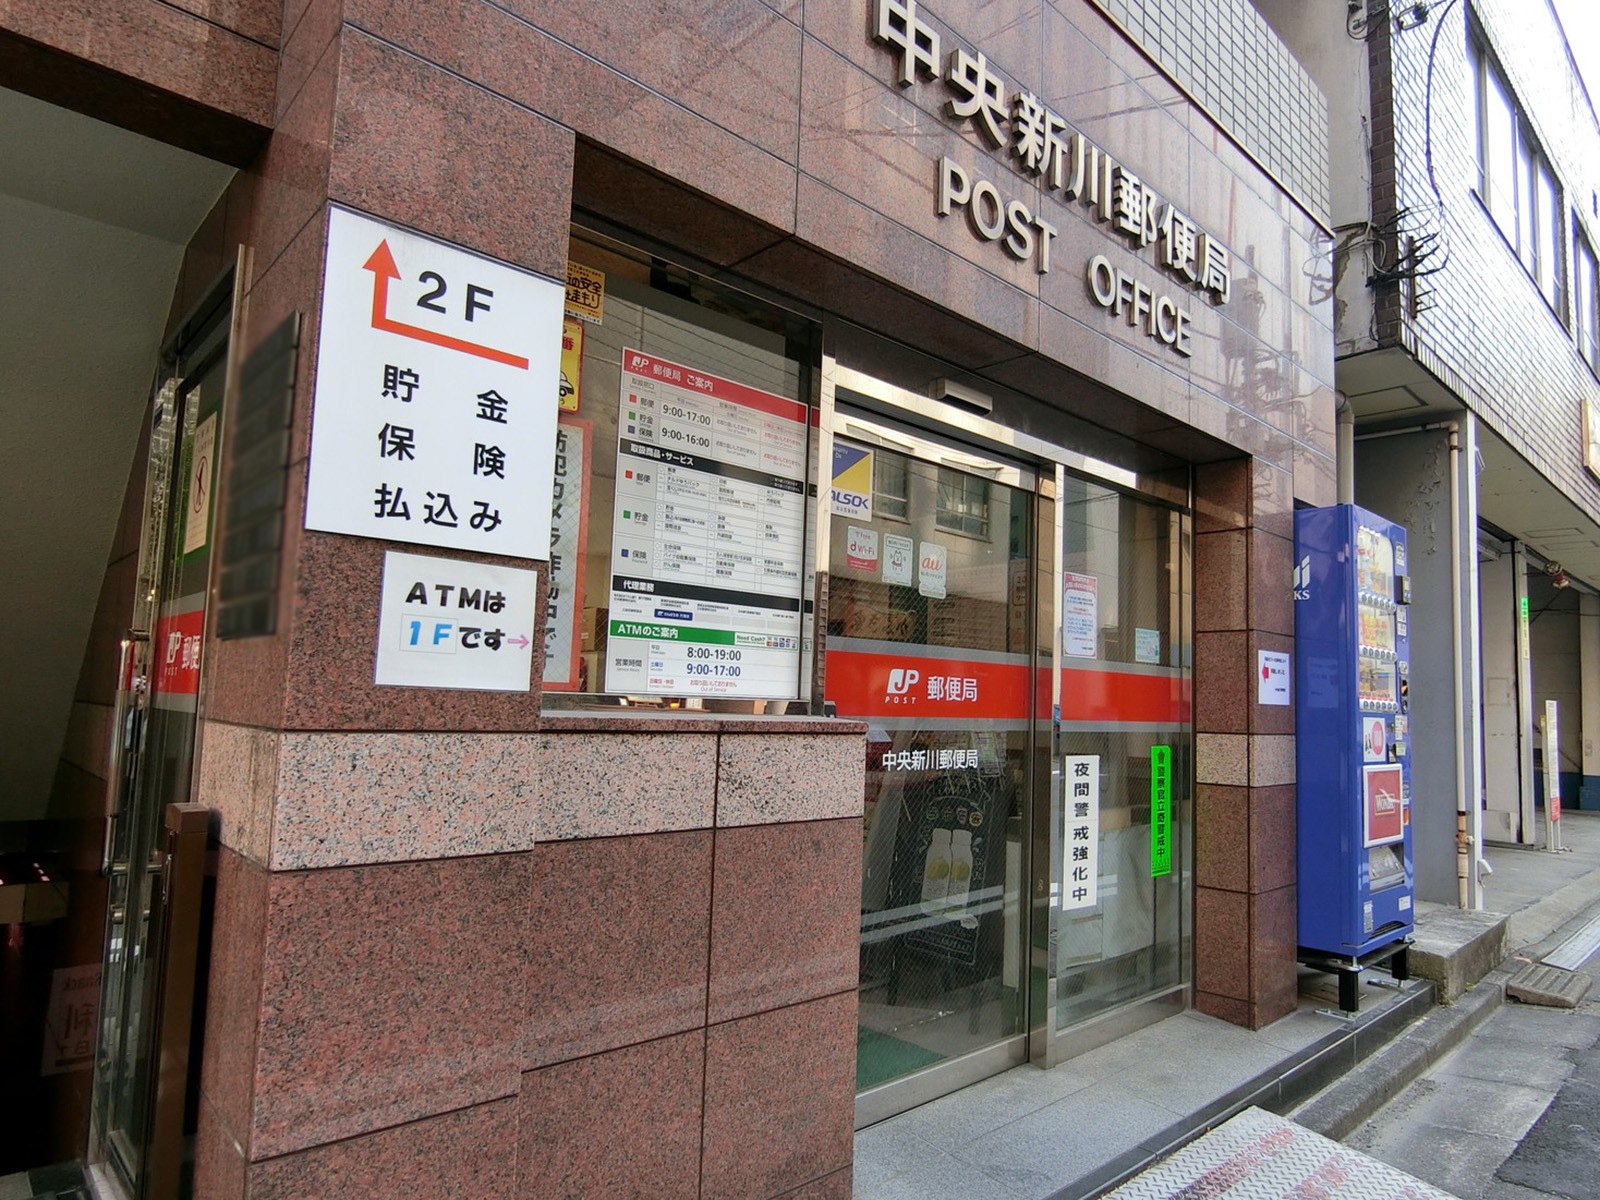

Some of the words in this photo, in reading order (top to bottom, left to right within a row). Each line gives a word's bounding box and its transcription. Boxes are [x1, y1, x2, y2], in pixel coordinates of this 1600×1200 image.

[873, 0, 1231, 305] 中央新川郵便局
[937, 156, 1057, 275] POST
[1086, 254, 1191, 357] OFFICE
[417, 270, 494, 323] 2F
[652, 364, 682, 383] 郵便局
[686, 374, 714, 392] ご案内
[381, 364, 509, 424] 貯金
[639, 413, 654, 425] 貯金
[662, 404, 711, 426] 9:00-17:00
[661, 427, 710, 448] 9:00-16:00
[378, 423, 507, 479] 保険
[636, 472, 651, 485] 郵便
[374, 483, 502, 532] 払込み
[634, 511, 649, 523] 貯金
[632, 550, 648, 560] 保険
[921, 557, 943, 572] au
[405, 581, 506, 614] ATMは
[1293, 589, 1310, 600] KS
[409, 620, 506, 651] 1Fです
[617, 624, 679, 640] ATMのご案内
[687, 646, 742, 662] 8:00-19:00
[686, 663, 741, 677] 9:00-17:00
[887, 668, 920, 694] JP
[884, 695, 918, 705] POST
[927, 675, 978, 702] 郵便局
[882, 749, 979, 772] 中央新川郵便局
[1072, 762, 1090, 902] 夜間警戒強化中
